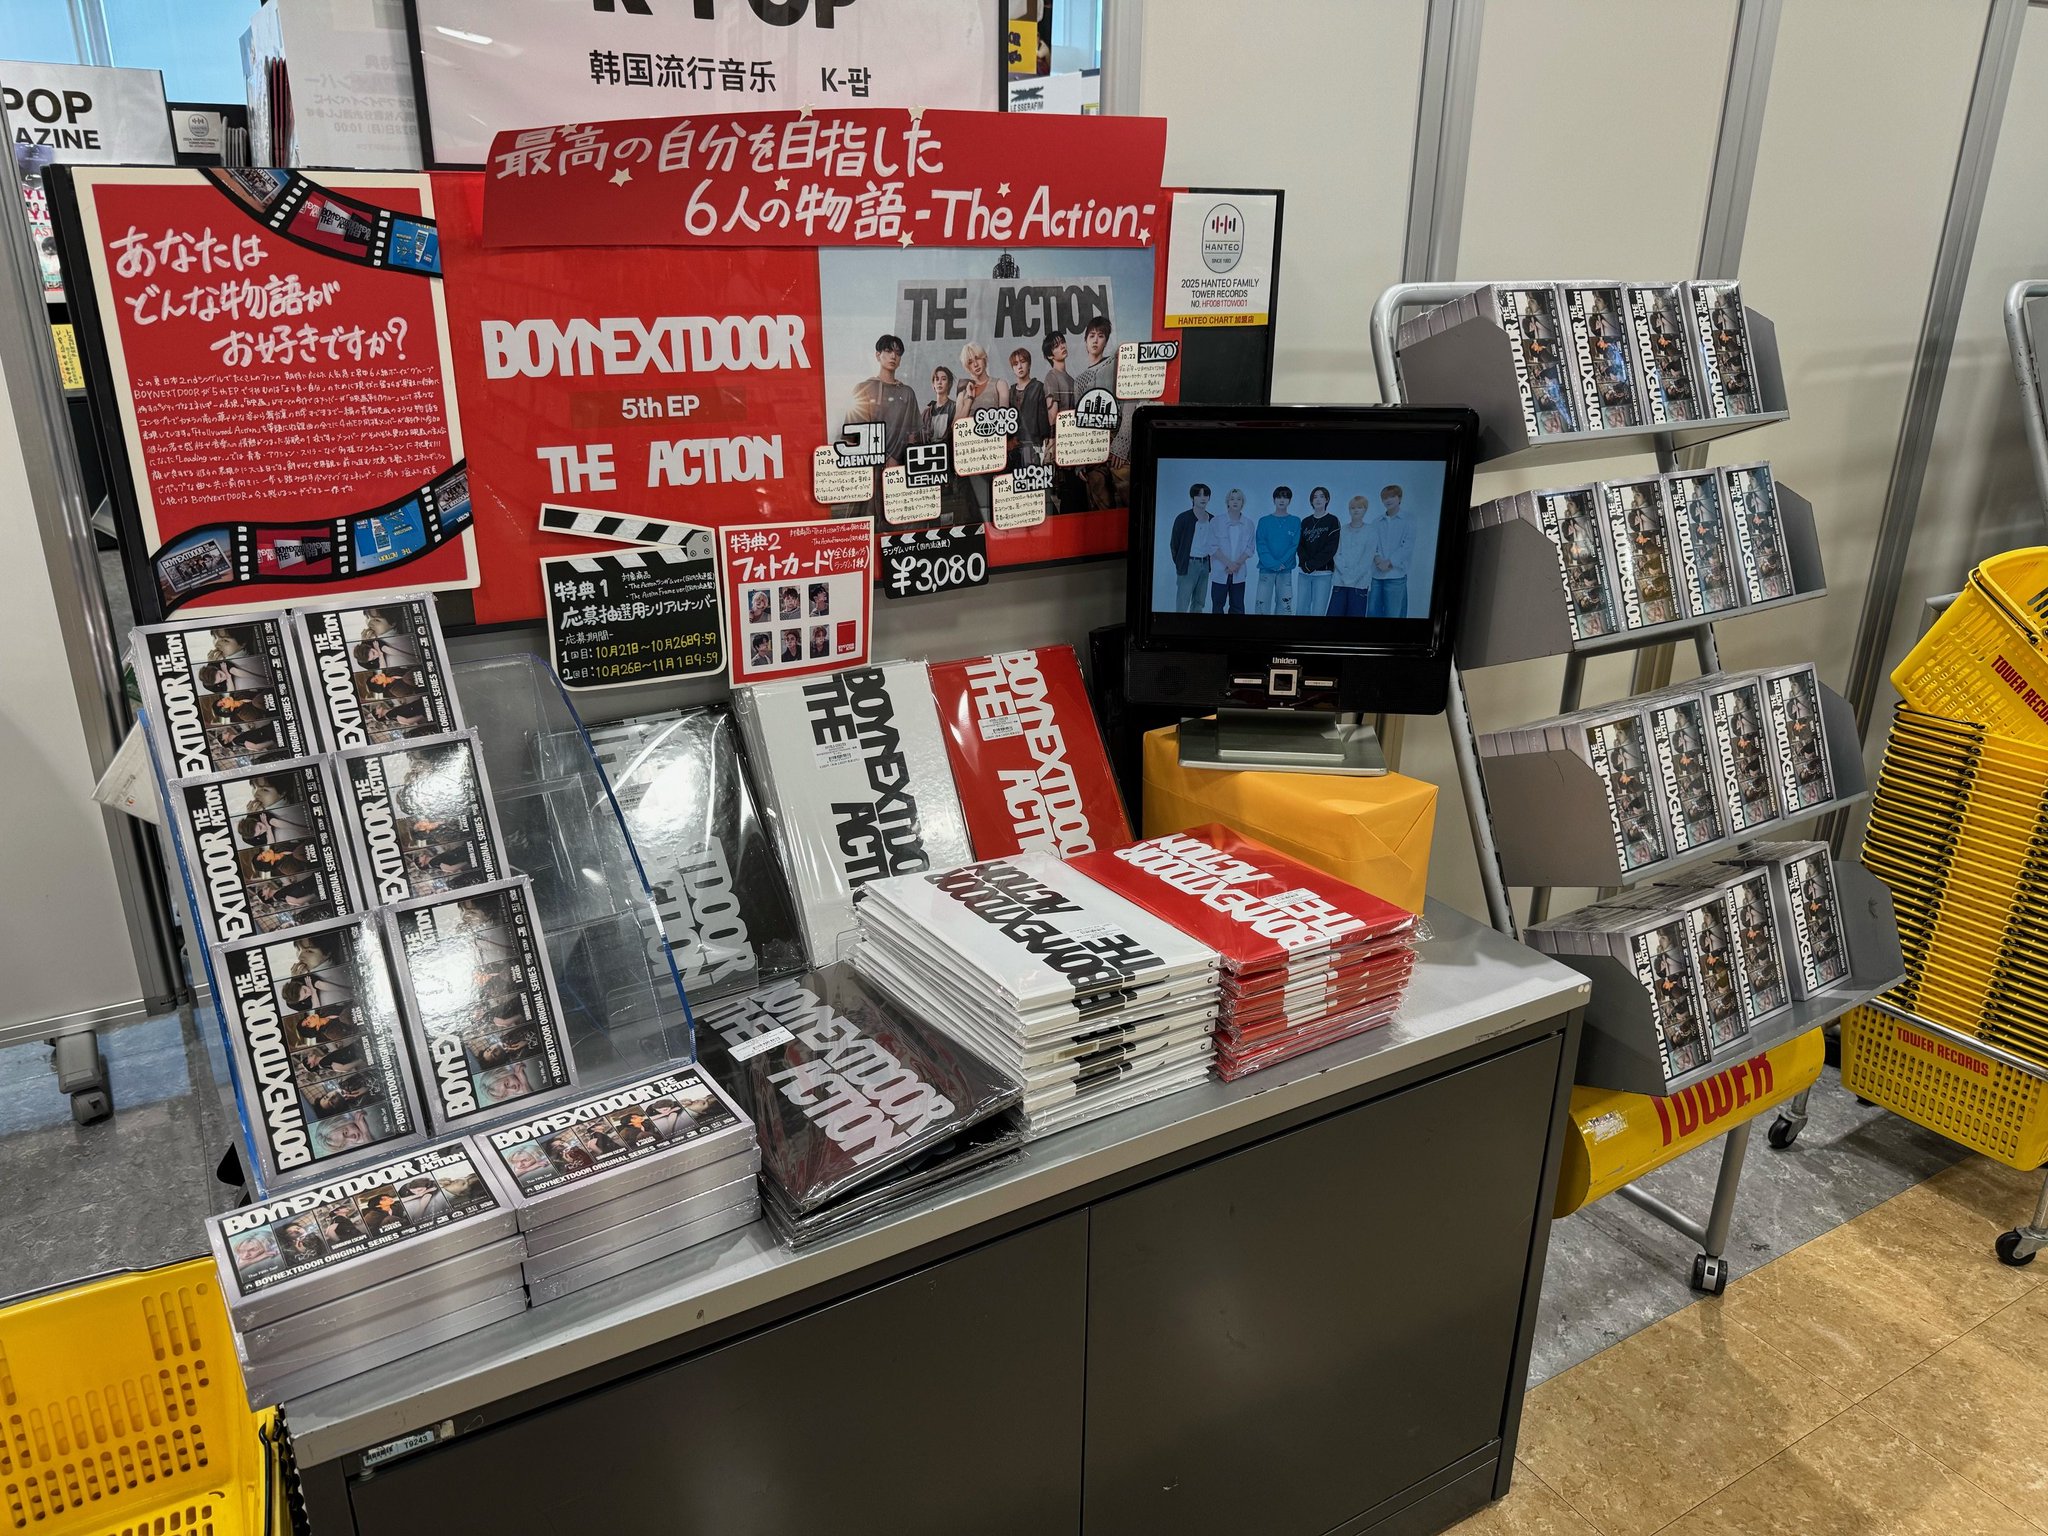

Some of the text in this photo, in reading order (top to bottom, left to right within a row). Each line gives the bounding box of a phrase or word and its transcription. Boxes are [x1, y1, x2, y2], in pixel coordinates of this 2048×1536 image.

[589, 50, 777, 93] 韩国流行音乐
[821, 66, 872, 98] K-팝
[494, 118, 945, 180] 最高の自分を目指した
[110, 225, 269, 279] あなたは
[1205, 243, 1240, 251] HANTEO
[124, 273, 341, 326] どんな物語が
[1181, 278, 1260, 288] 2025 HANTEO FAMILY
[1192, 289, 1248, 299] TOWER RECORDS
[903, 283, 1110, 342] THE ACTION
[1178, 316, 1208, 325] HANTEO
[1209, 315, 1234, 324] CHART
[1635, 289, 1648, 321] ACTION
[480, 314, 812, 380] BOYNEXTDOOR
[1573, 320, 1604, 432] BOYNEXTDOOR
[1634, 318, 1668, 426] BOYNEXTDOOR
[1696, 315, 1729, 420] BOYNEXTDOOR
[622, 394, 701, 420] 5th EP
[977, 409, 1017, 421] SUNG
[1076, 412, 1118, 429] TAESAN
[997, 422, 1017, 434] HO
[536, 443, 617, 494] THE
[647, 434, 784, 488] ACTION
[836, 454, 886, 468] JAEHYUN
[907, 473, 949, 487] LEEHAN
[1013, 464, 1054, 481] WOON
[1027, 475, 1054, 491] HAK
[1675, 479, 1687, 511] ACTION
[162, 546, 204, 569] BOYNEXTDOOR
[730, 532, 782, 554] 特典2
[1673, 508, 1705, 617] BOYNEXTDOOR
[1731, 499, 1763, 604] BOYNEXTDOOR
[732, 549, 833, 582] フォトカード
[891, 552, 986, 596] ¥3,080
[560, 593, 717, 631] 応募抽選用シリアルナンバー
[165, 633, 189, 677] ACTION
[313, 631, 331, 655] THE
[322, 612, 346, 658] ACTION
[157, 654, 175, 677] THE
[1272, 657, 1298, 666] Uniden
[1990, 655, 2028, 696] TOWER
[281, 696, 292, 718] SERIES
[964, 656, 1019, 720] THE
[801, 673, 859, 746] THE
[1716, 694, 1728, 725] ACTION
[284, 717, 302, 753] ORIGINAL
[1593, 728, 1606, 760] ACTION
[363, 757, 389, 800] ACTION
[1714, 723, 1747, 832] BOYNEXTDOOR
[1769, 708, 1802, 813] BOYNEXTDOOR
[203, 784, 227, 831] ACTION
[357, 778, 374, 801] THE
[192, 807, 211, 832] THE
[322, 845, 335, 870] SERIES
[1147, 832, 1278, 887] ACTION
[329, 867, 346, 905] ORIGINAL
[961, 860, 1085, 917] ACTION
[1112, 843, 1318, 951] BOYNEXTDOOR
[1790, 863, 1801, 893] ACTION
[923, 867, 1124, 993] BOYNEXTDOOR
[1284, 889, 1368, 938] THE
[1078, 932, 1167, 984] THE
[1788, 890, 1820, 993] BOYNEXTDOOR
[233, 974, 253, 999] THE
[244, 948, 274, 997] ACTION
[526, 966, 542, 990] SERIES
[532, 988, 550, 1025] ORIGINAL
[376, 1032, 393, 1071] ORIGINAL
[540, 1023, 562, 1087] BOYNEXTDOOR
[1896, 1026, 1989, 1078] TOWER RECORDS
[242, 993, 313, 1172] BOYNEXTDOOR
[384, 1069, 407, 1127] BOYNEXTDOOR
[653, 1076, 679, 1089] THE
[661, 1075, 702, 1096] ACTION
[1651, 1052, 1774, 1147] TOWER
[490, 1085, 662, 1151] BOYNEXTDOOR
[766, 1057, 910, 1167] ACTION
[414, 1151, 441, 1165] THE
[420, 1151, 467, 1173] ACTION
[533, 1167, 593, 1191] BOYNEXTDOOR
[592, 1153, 630, 1171] ORIGINAL
[628, 1145, 657, 1159] SERIES
[222, 1160, 423, 1236] BOYNEXTDOOR
[254, 1257, 325, 1288] BOYNEXTDOOR
[325, 1244, 369, 1264] ORIGINAL
[367, 1232, 400, 1248] SERIES
[404, 1434, 428, 1449] T9243
